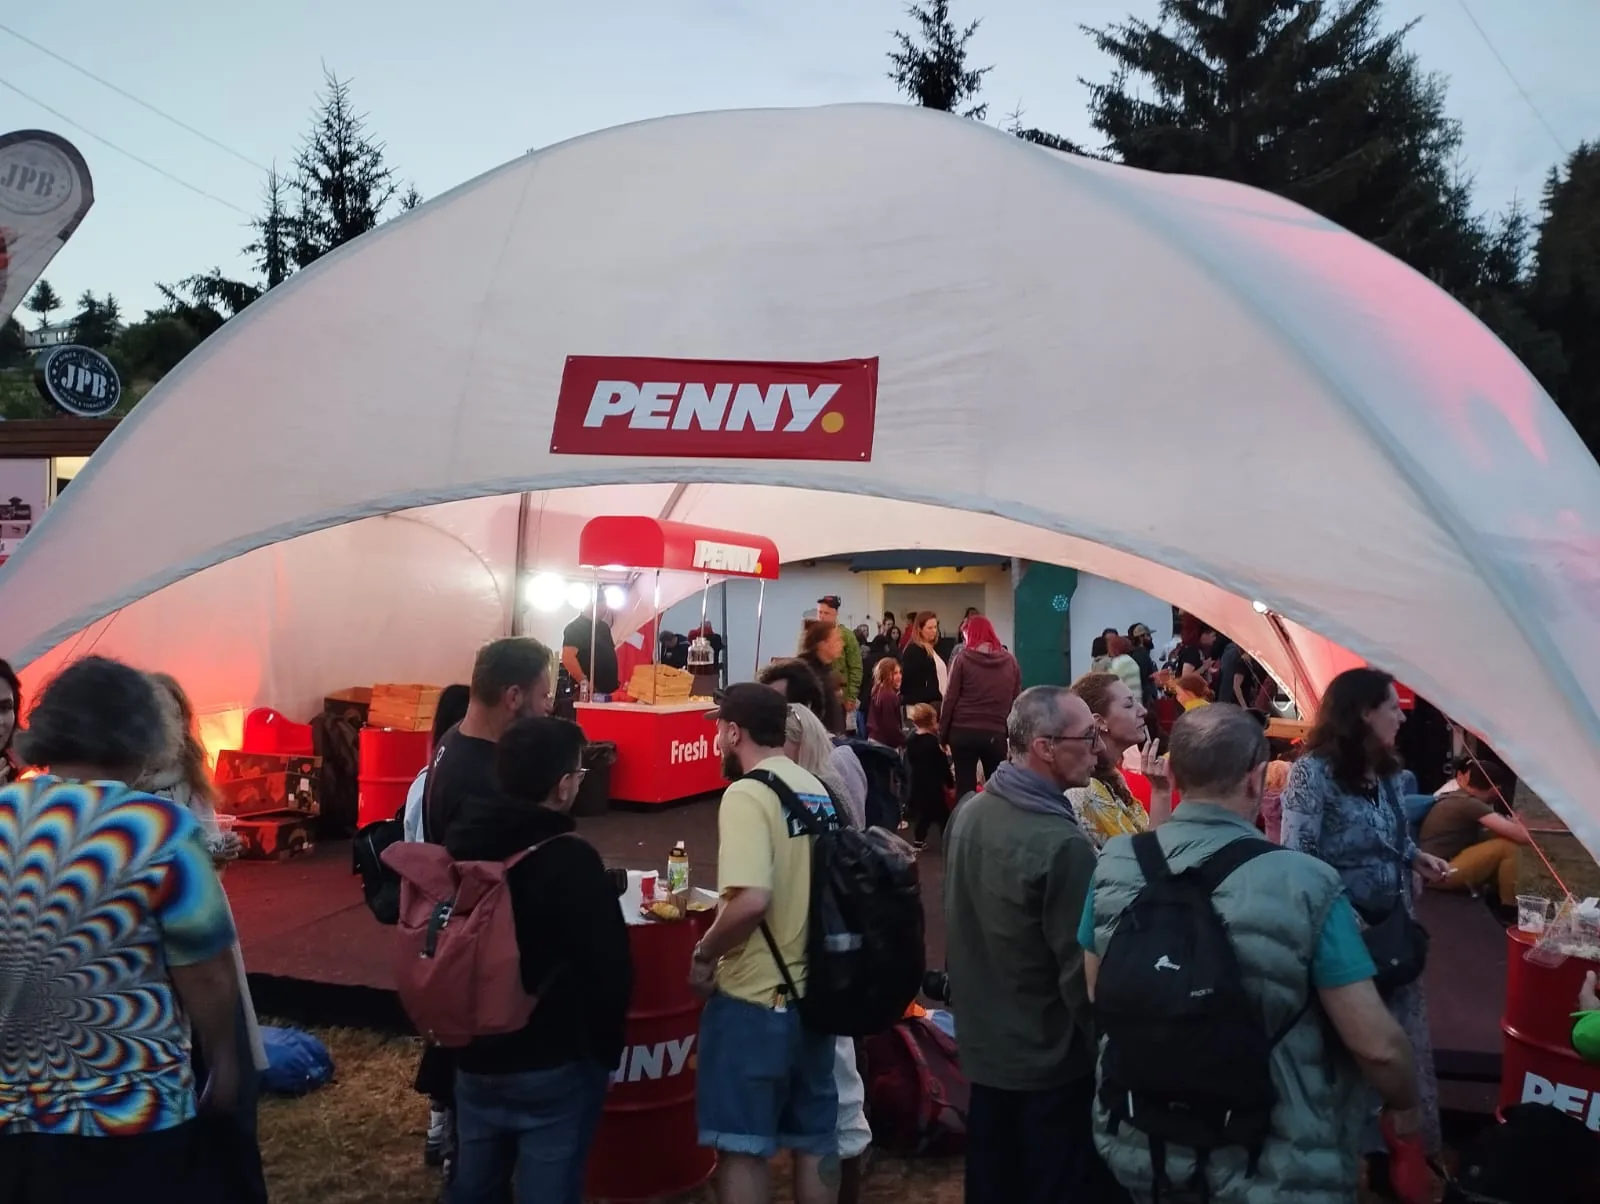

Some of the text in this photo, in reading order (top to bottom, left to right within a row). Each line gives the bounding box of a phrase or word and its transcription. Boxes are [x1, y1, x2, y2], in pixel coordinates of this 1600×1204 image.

[0, 163, 55, 197] JPB
[61, 363, 107, 398] JPB
[671, 734, 708, 765] Fresh
